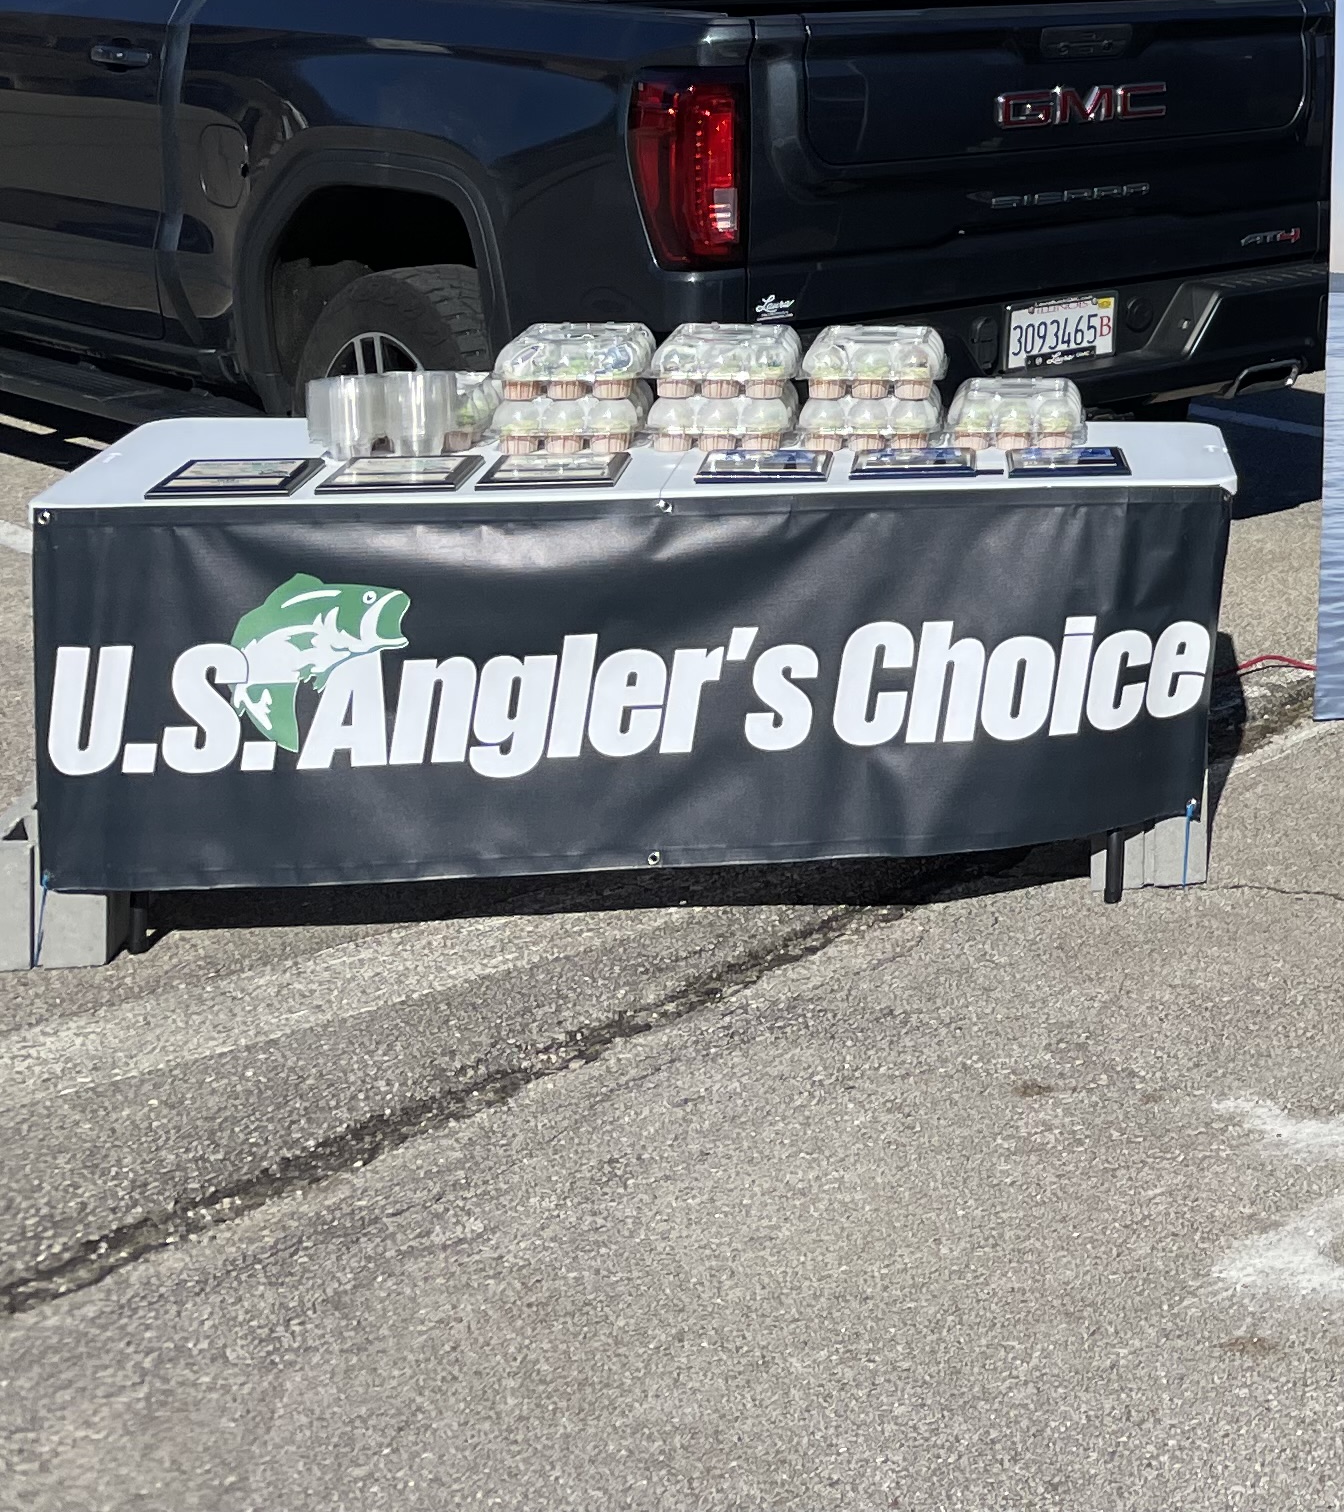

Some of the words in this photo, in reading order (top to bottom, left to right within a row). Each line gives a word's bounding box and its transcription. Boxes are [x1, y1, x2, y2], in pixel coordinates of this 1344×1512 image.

[997, 82, 1166, 129] GMC
[991, 183, 1149, 208] SIERRA
[47, 643, 276, 776] U.S.
[296, 627, 818, 778] Angler's
[832, 616, 1210, 746] Choice
